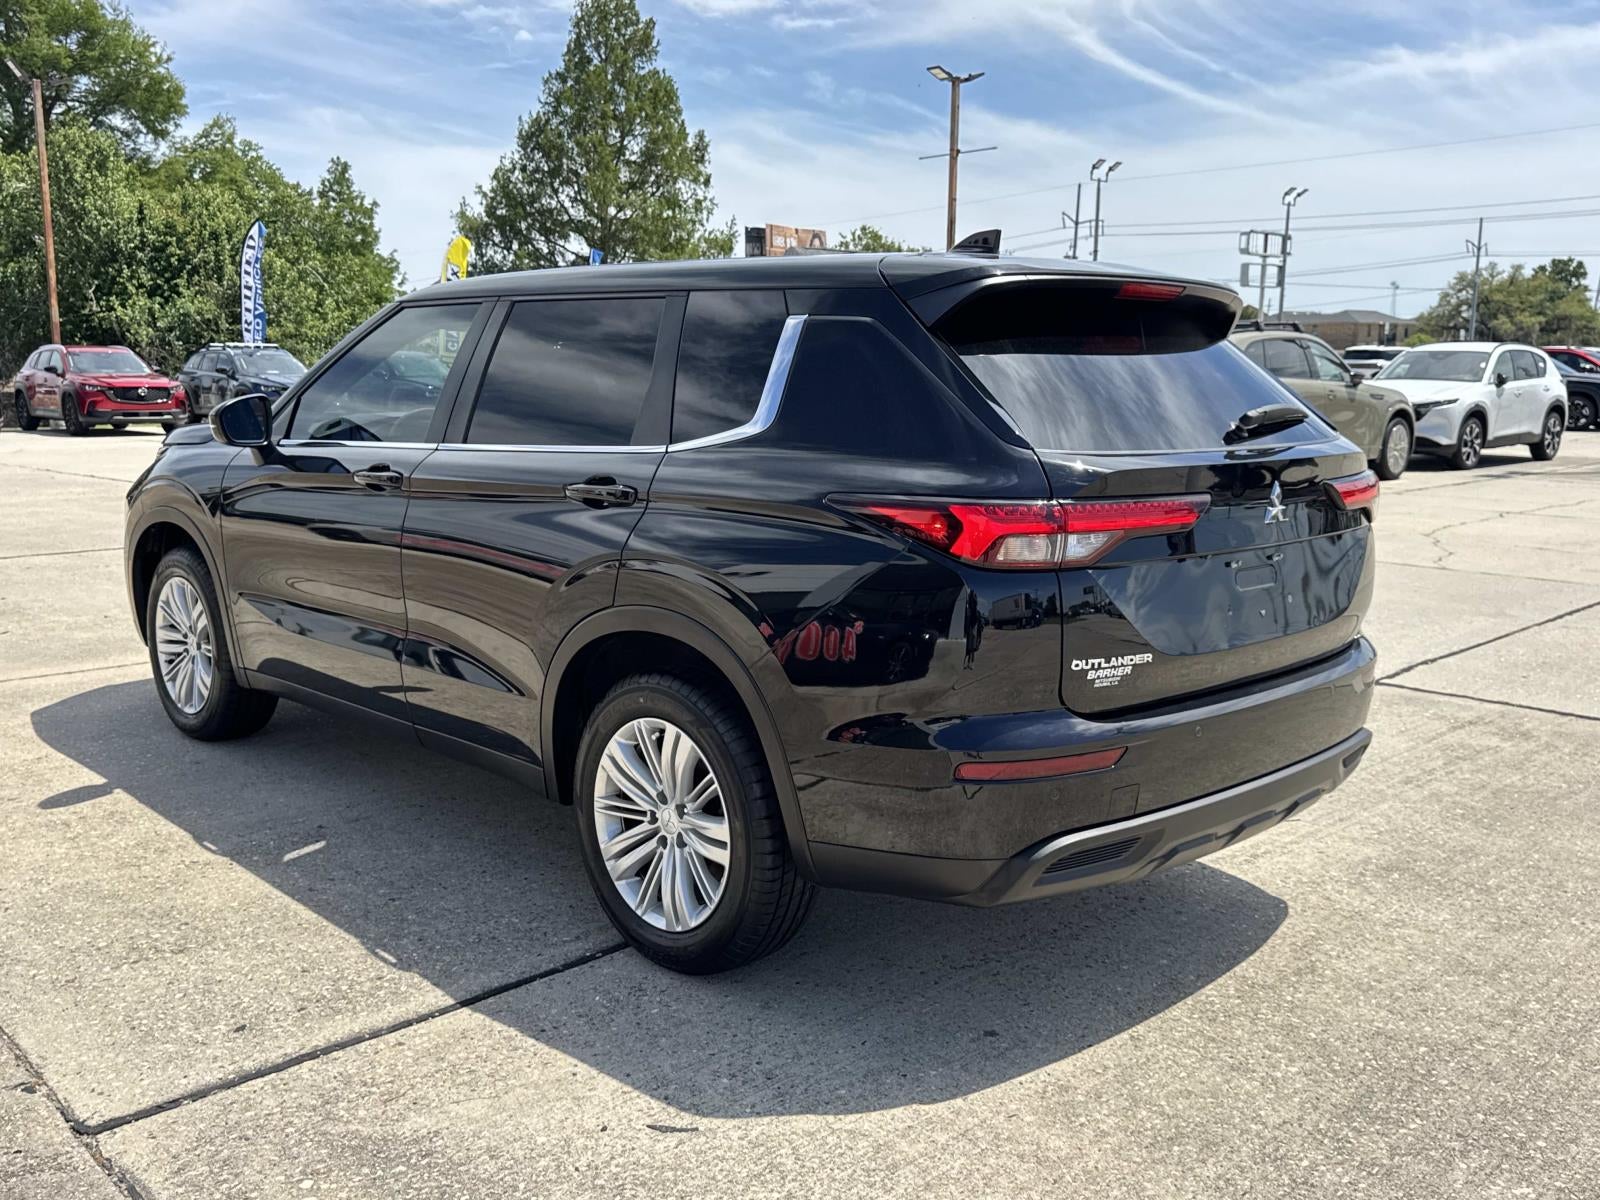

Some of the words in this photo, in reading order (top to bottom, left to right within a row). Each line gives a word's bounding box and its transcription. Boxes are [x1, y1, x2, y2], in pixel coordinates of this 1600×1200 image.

[243, 234, 257, 343] RTIFIED
[1071, 653, 1153, 671] OUTLANDER
[1087, 665, 1133, 680] BARKER
